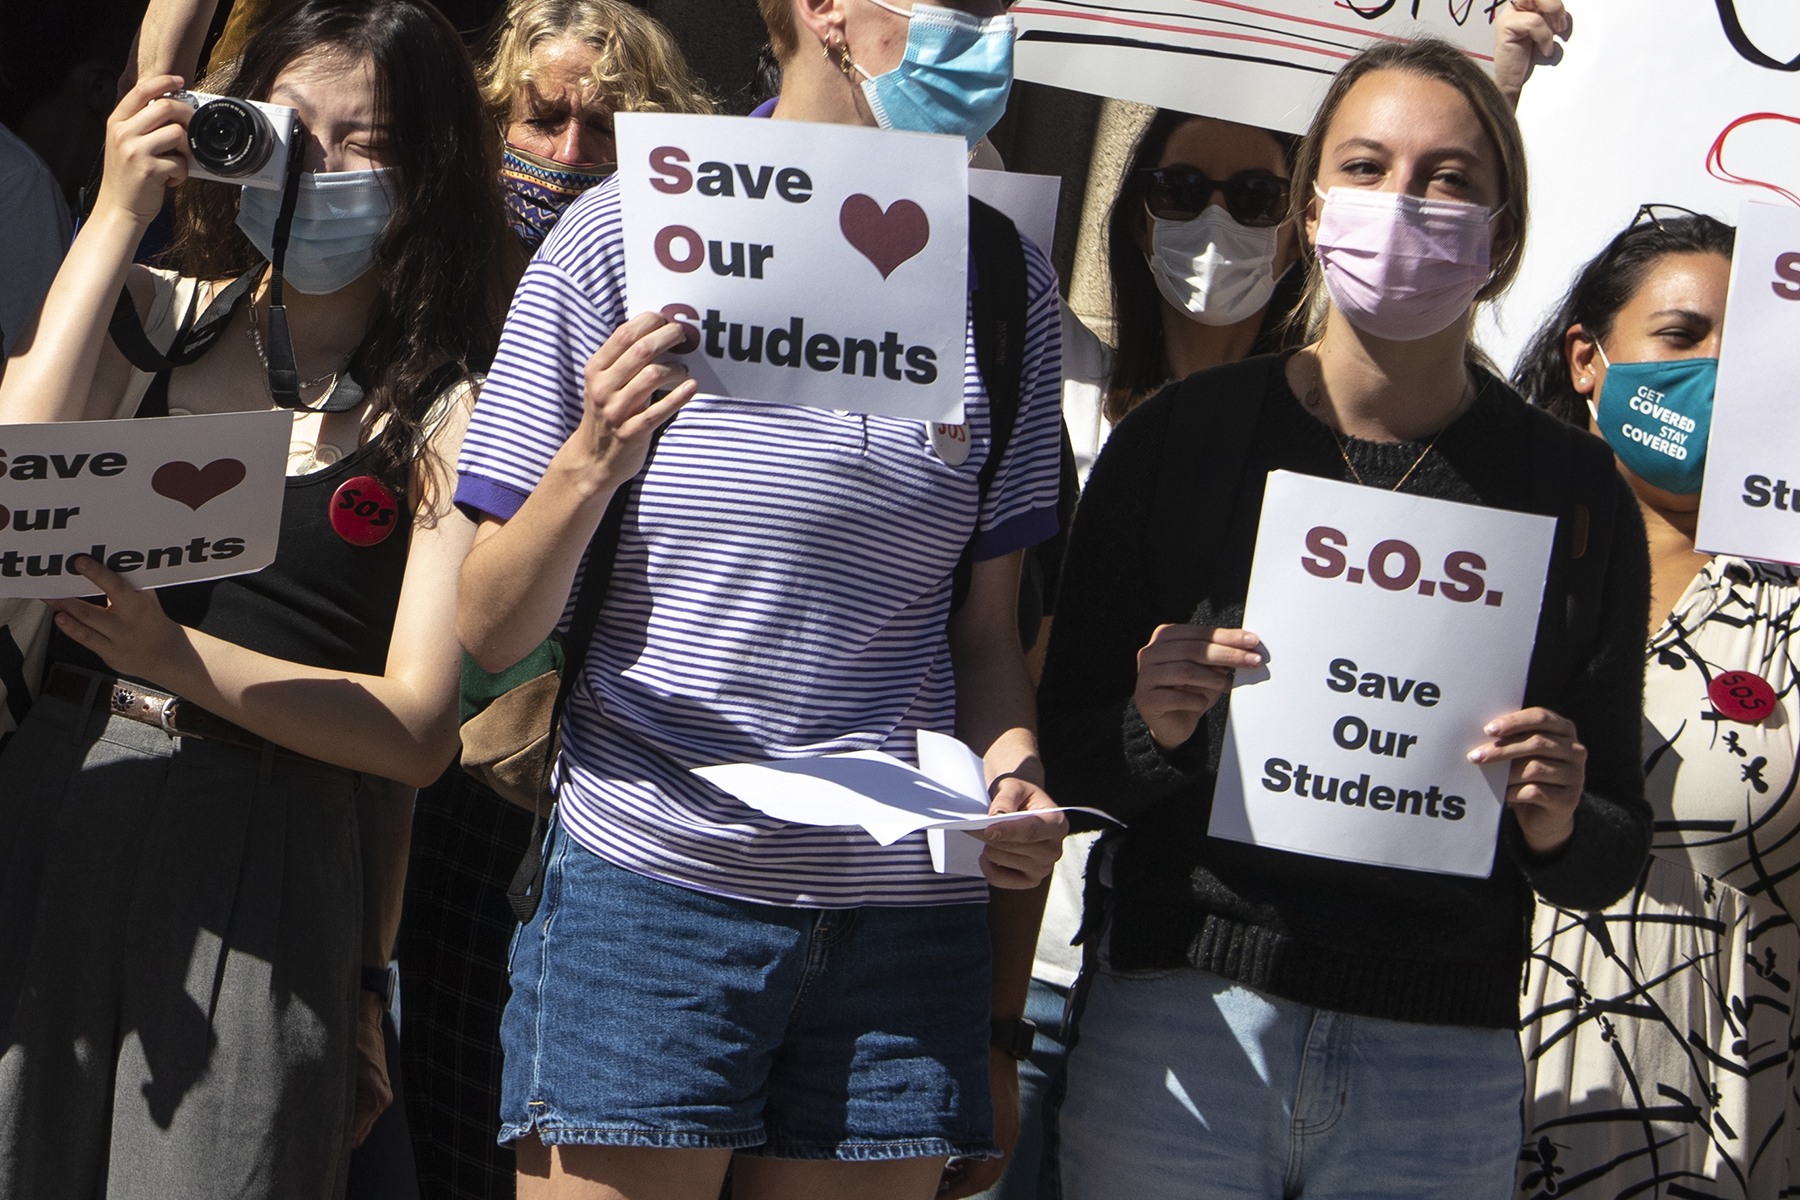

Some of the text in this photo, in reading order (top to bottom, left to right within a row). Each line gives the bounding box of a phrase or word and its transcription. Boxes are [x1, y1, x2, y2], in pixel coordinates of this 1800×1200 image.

[648, 146, 813, 204] Save
[654, 224, 774, 280] Our
[658, 303, 938, 385] Students
[1629, 396, 1696, 433] COVERED
[1637, 385, 1665, 403] GET
[1622, 424, 1688, 460] COVERED
[1659, 426, 1688, 445] STAY
[338, 489, 395, 527] SOS
[1301, 526, 1504, 607] S.O.S.
[1326, 658, 1441, 708] Save
[1721, 674, 1767, 710] SOS
[1332, 715, 1417, 759] Our
[1261, 758, 1467, 822] Students
